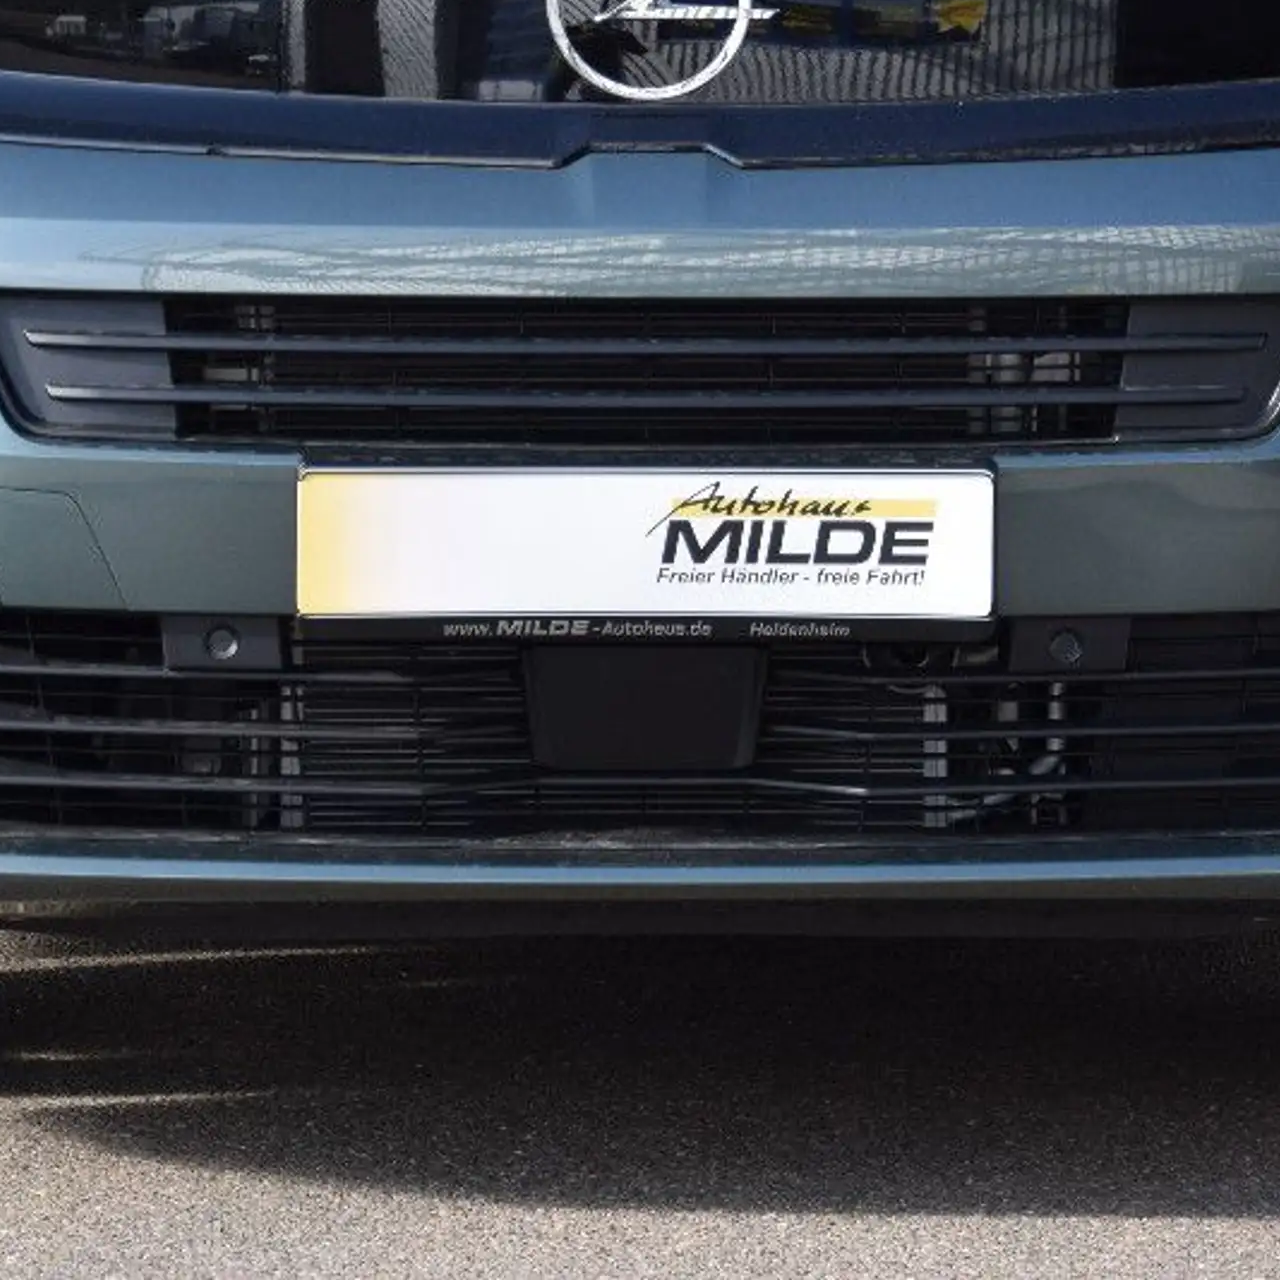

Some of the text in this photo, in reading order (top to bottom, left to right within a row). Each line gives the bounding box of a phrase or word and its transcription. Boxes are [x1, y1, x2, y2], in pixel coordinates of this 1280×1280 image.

[645, 481, 873, 538] Autohaus
[661, 519, 934, 566] MILDE
[656, 567, 714, 584] Freier
[720, 568, 798, 584] Händler
[817, 568, 860, 584] freie
[865, 569, 926, 586] Fahrt!
